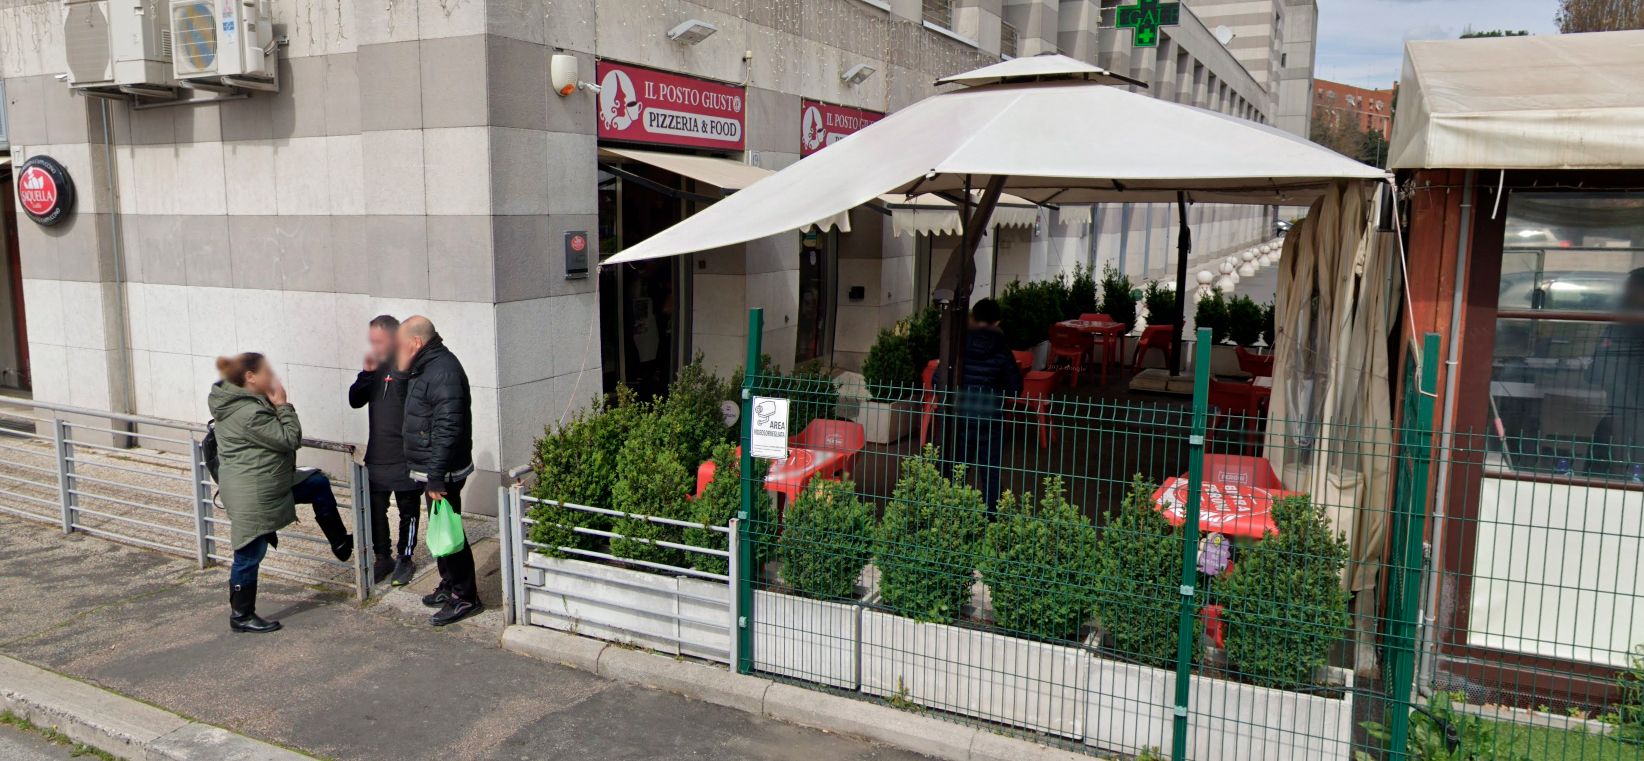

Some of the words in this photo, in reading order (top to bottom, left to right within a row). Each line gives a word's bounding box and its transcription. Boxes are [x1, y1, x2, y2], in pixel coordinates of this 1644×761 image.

[645, 81, 657, 99] IL
[659, 84, 699, 106] POSTO
[702, 91, 741, 112] GIUSTO
[649, 112, 699, 132] PIZZERIA
[701, 120, 708, 134] &
[710, 121, 737, 136] FOOD
[827, 112, 833, 126] IL
[834, 114, 858, 129] POSTO
[769, 420, 786, 430] AREA
